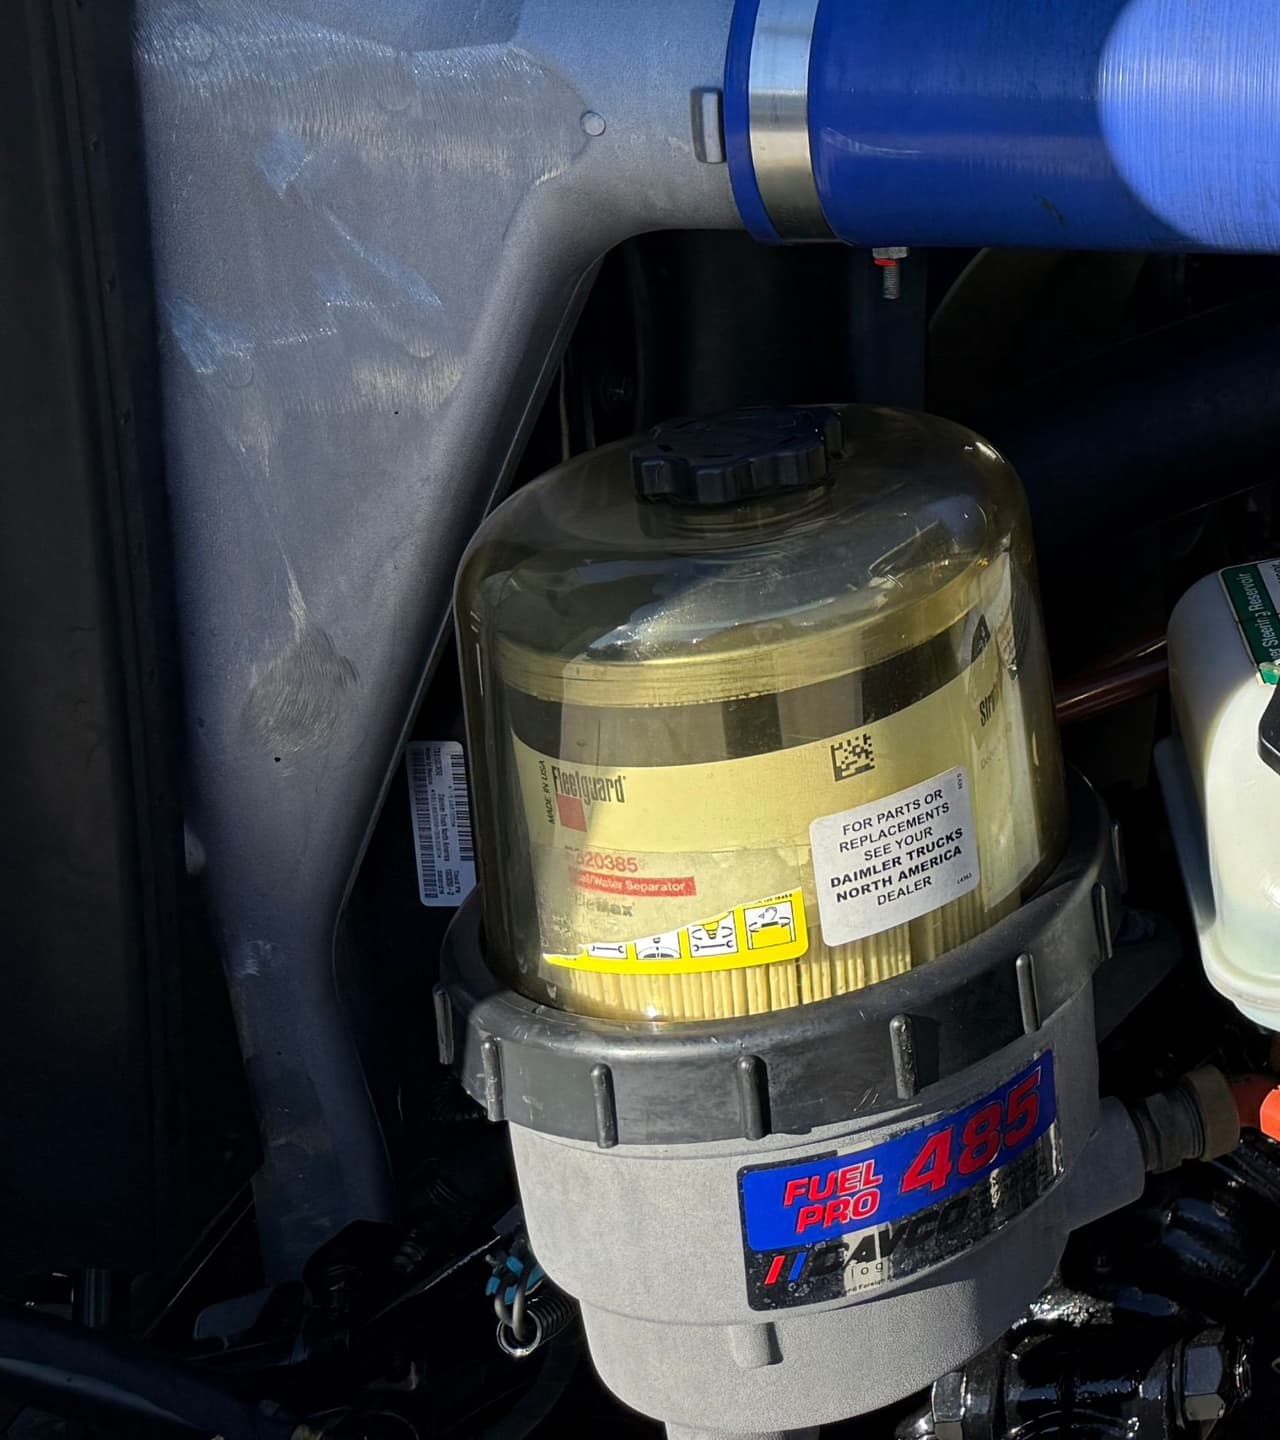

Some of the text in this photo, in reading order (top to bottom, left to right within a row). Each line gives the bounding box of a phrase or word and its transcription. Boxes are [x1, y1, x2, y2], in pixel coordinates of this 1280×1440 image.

[1238, 572, 1266, 614] Reservoir
[537, 760, 554, 780] USA
[551, 765, 627, 806] Fleetguard
[543, 799, 556, 825] MADE
[839, 802, 950, 853] REPLACEMENTS
[842, 789, 944, 836] FOR PARTS OR
[830, 827, 964, 889] DAIMLER TRUCKS
[863, 826, 934, 862] SEE YOUR
[626, 879, 687, 892] Separator
[835, 846, 963, 904] NORTH AMERICA
[877, 876, 933, 906] DEALER
[899, 1066, 1042, 1195] 485
[784, 1159, 884, 1208] FUEL
[796, 1188, 881, 1235] PRO
